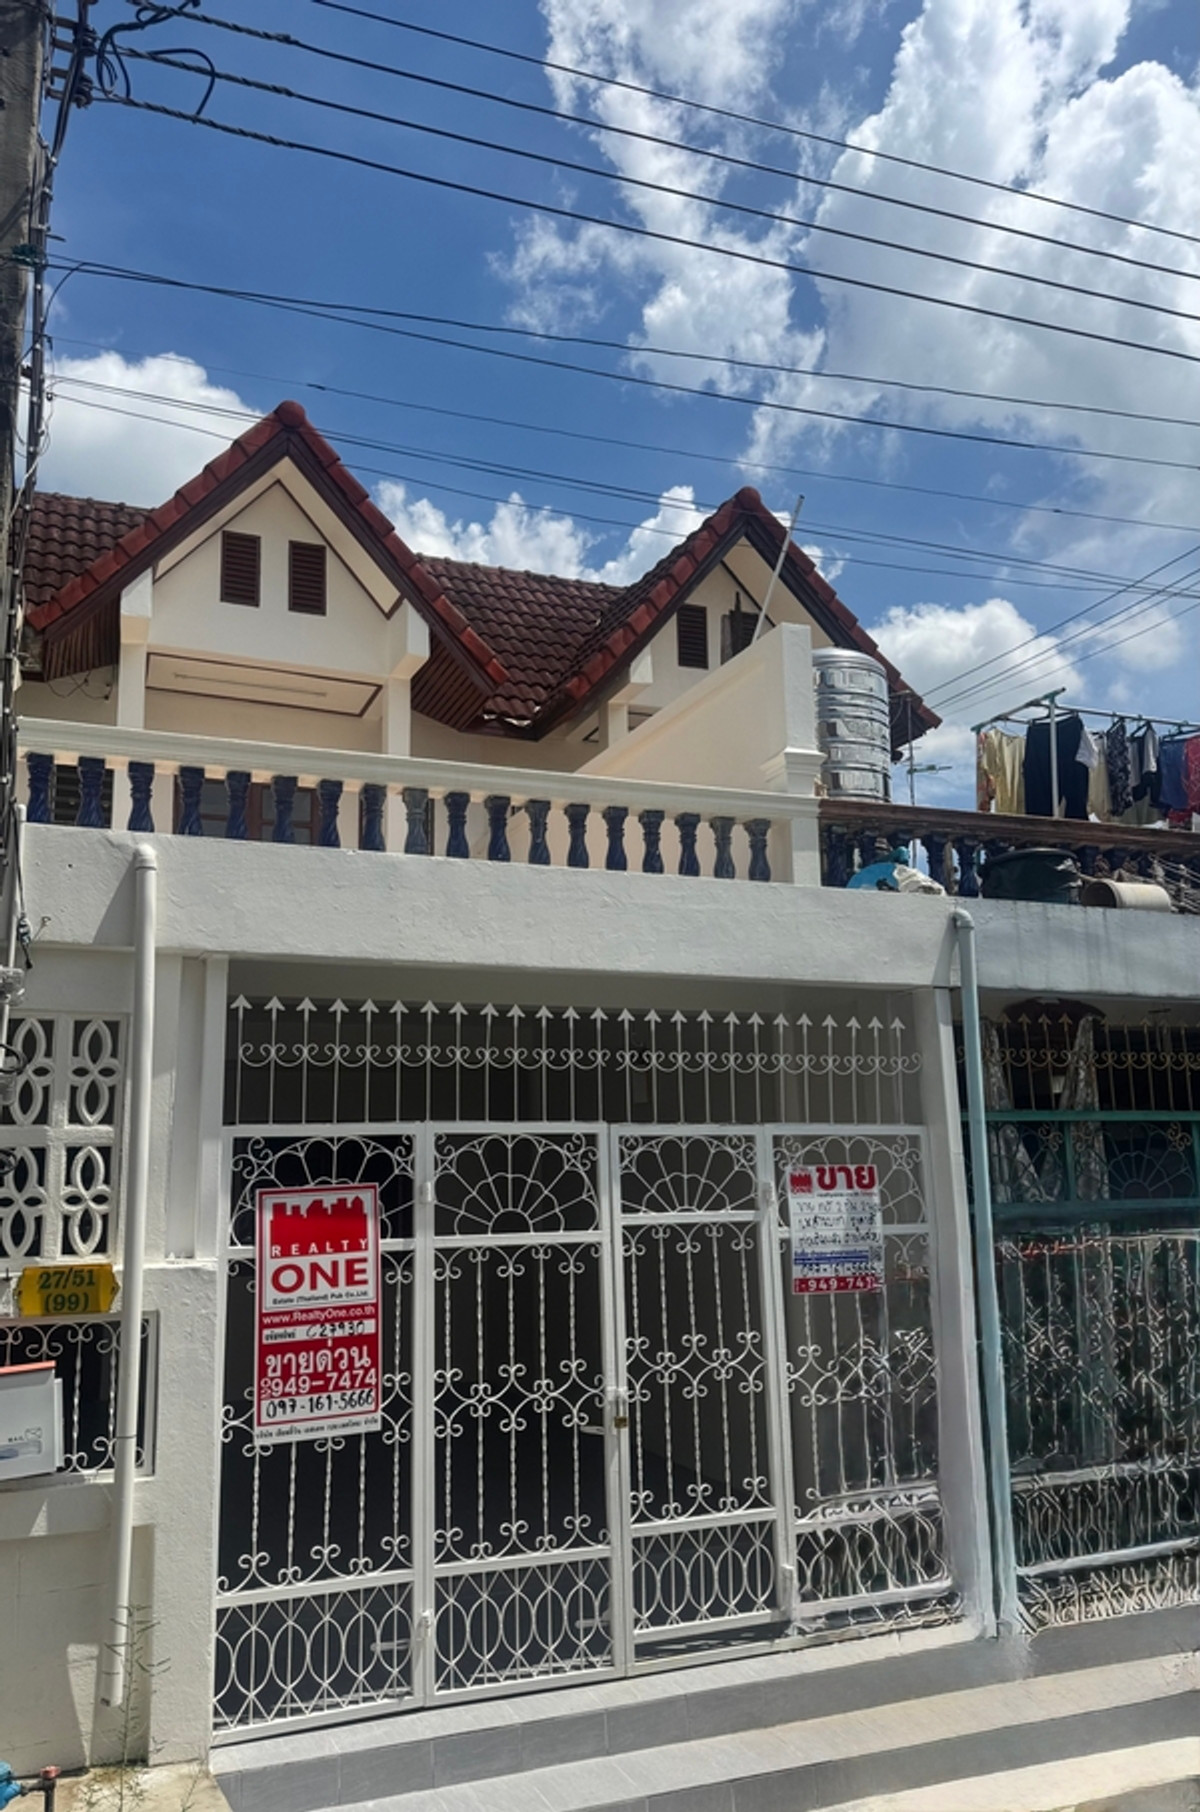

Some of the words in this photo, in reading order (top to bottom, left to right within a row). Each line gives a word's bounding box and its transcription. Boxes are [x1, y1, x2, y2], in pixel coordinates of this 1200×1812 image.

[816, 1165, 876, 1190] ขาย
[271, 1239, 368, 1257] REALTY
[39, 1268, 95, 1290] 27/51
[271, 1258, 368, 1293] ONE
[44, 1292, 89, 1313] (99)
[263, 1305, 375, 1325] www.RealtyOne.co.th
[266, 1338, 371, 1377] ขายด่วน
[266, 1388, 375, 1418] 097-161-5666
